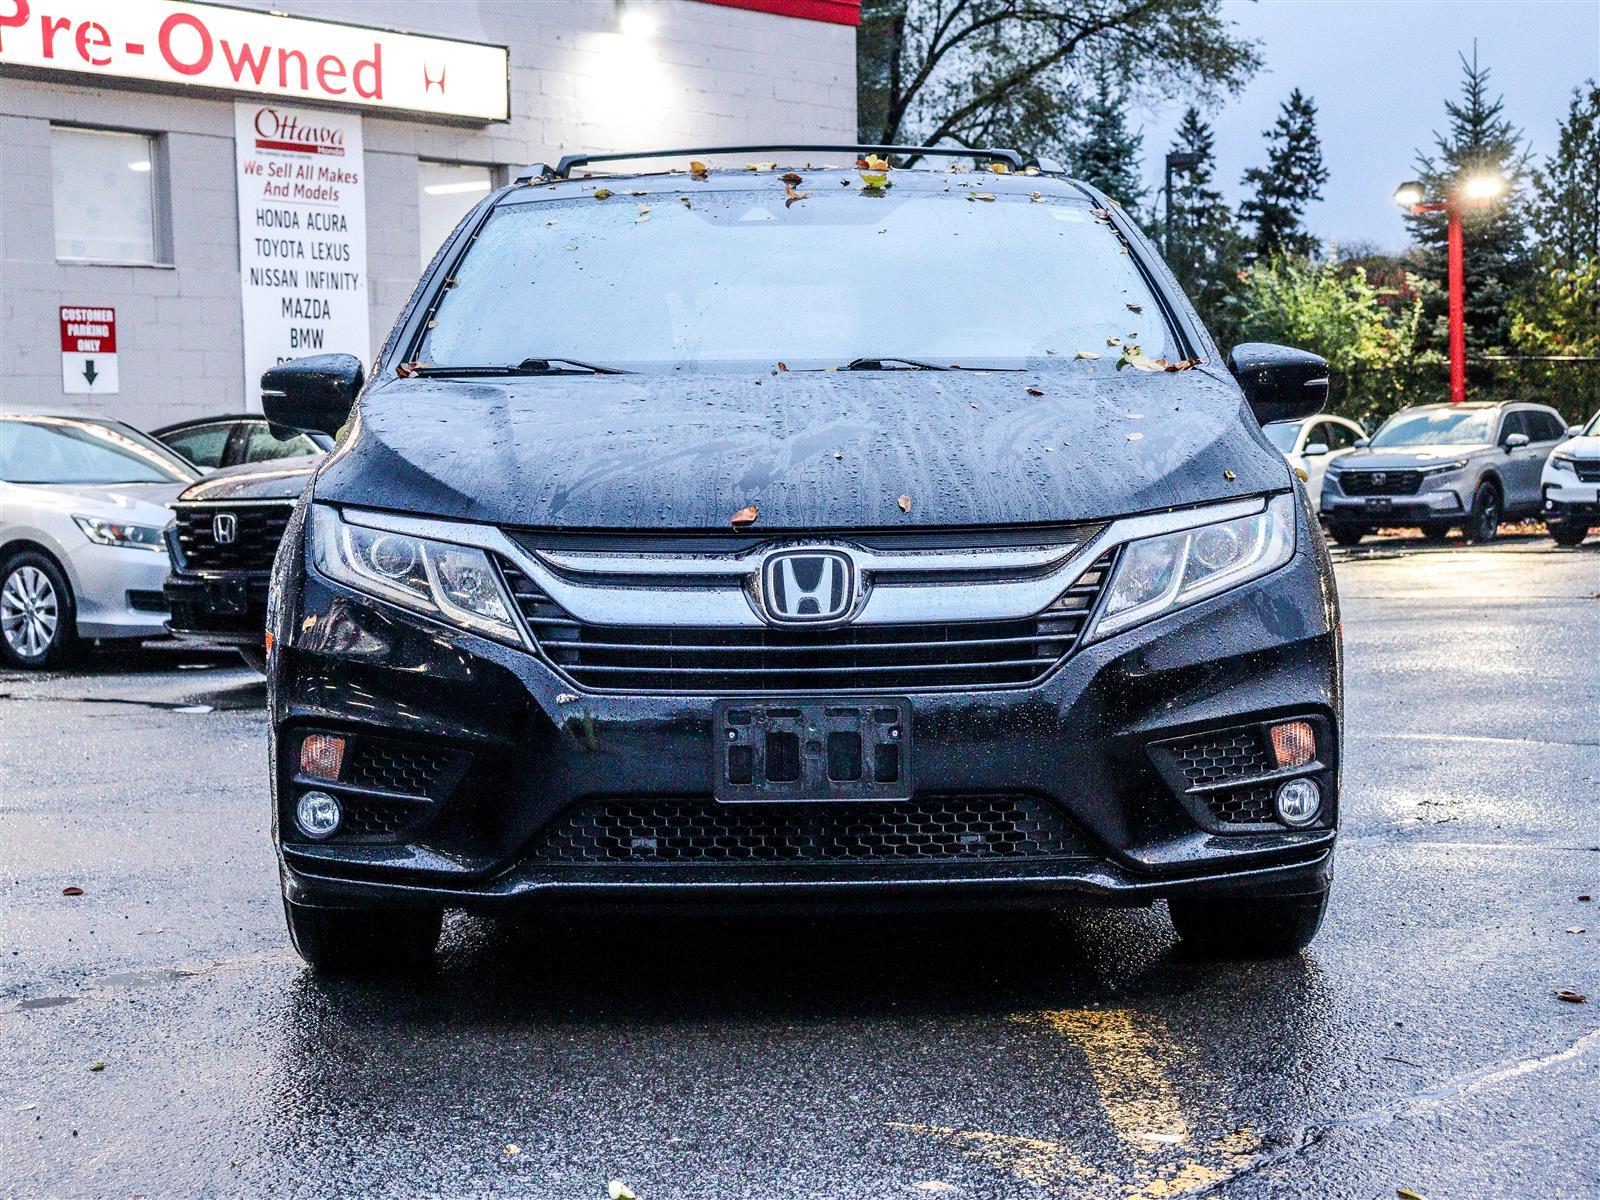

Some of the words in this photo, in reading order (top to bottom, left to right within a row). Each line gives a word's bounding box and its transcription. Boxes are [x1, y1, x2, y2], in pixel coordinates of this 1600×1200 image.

[0, 0, 384, 100] Pre-Owned
[255, 107, 343, 145] Ottawa
[244, 160, 263, 176] We
[268, 162, 292, 178] Sell
[296, 165, 314, 180] All
[318, 167, 359, 184] Makes
[264, 181, 290, 197] And
[294, 184, 340, 201] Models
[256, 208, 300, 229] HONDA
[307, 212, 348, 232] ACURA
[255, 238, 305, 259] TOYOTA
[311, 242, 350, 262] LEXUS
[250, 267, 298, 288] NISSAN
[305, 271, 359, 291] INFINITY
[61, 308, 114, 322] CUSTOMER
[281, 297, 331, 320] MAZDA
[67, 323, 110, 337] PARKING
[290, 328, 324, 349] BMW
[77, 339, 101, 352] ONLY
